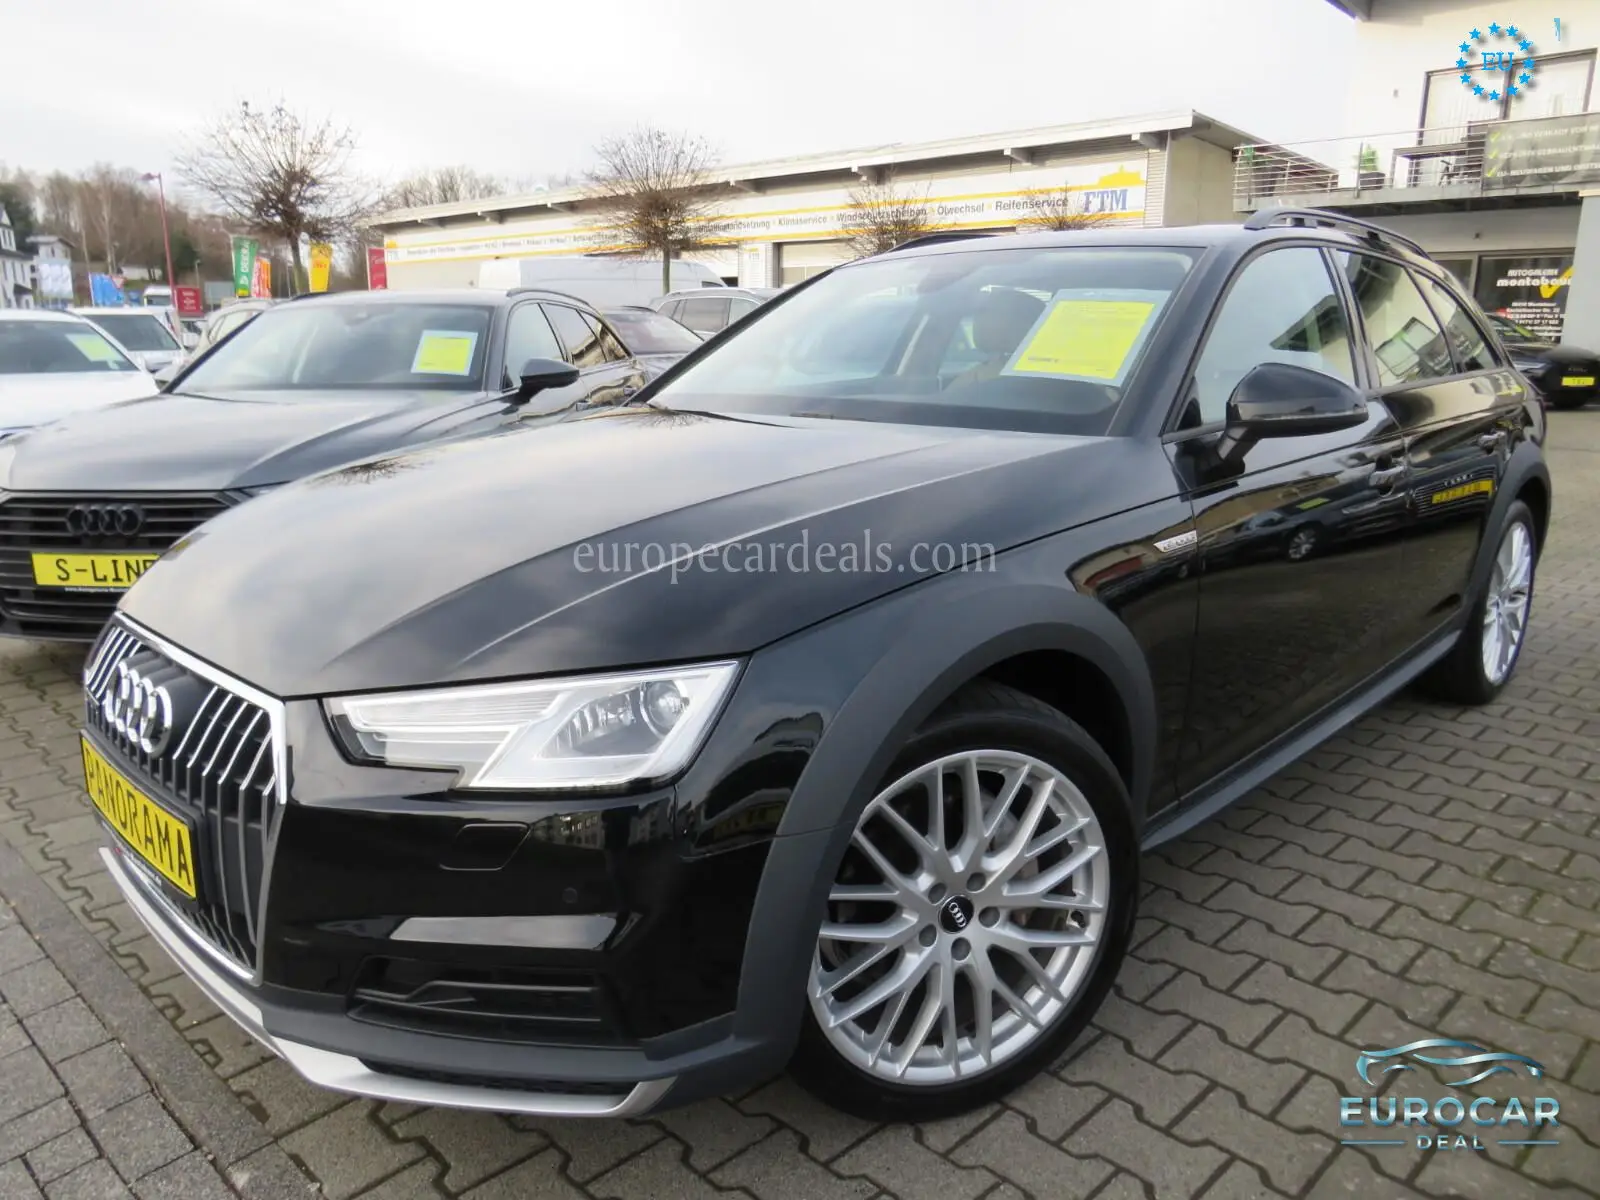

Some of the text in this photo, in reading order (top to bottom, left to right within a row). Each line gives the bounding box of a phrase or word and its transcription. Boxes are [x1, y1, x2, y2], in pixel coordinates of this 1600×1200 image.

[778, 215, 827, 227] Klimaservice
[995, 197, 1069, 211] Reifenservice
[1083, 189, 1128, 213] FTM
[85, 746, 192, 887] PANORAMA
